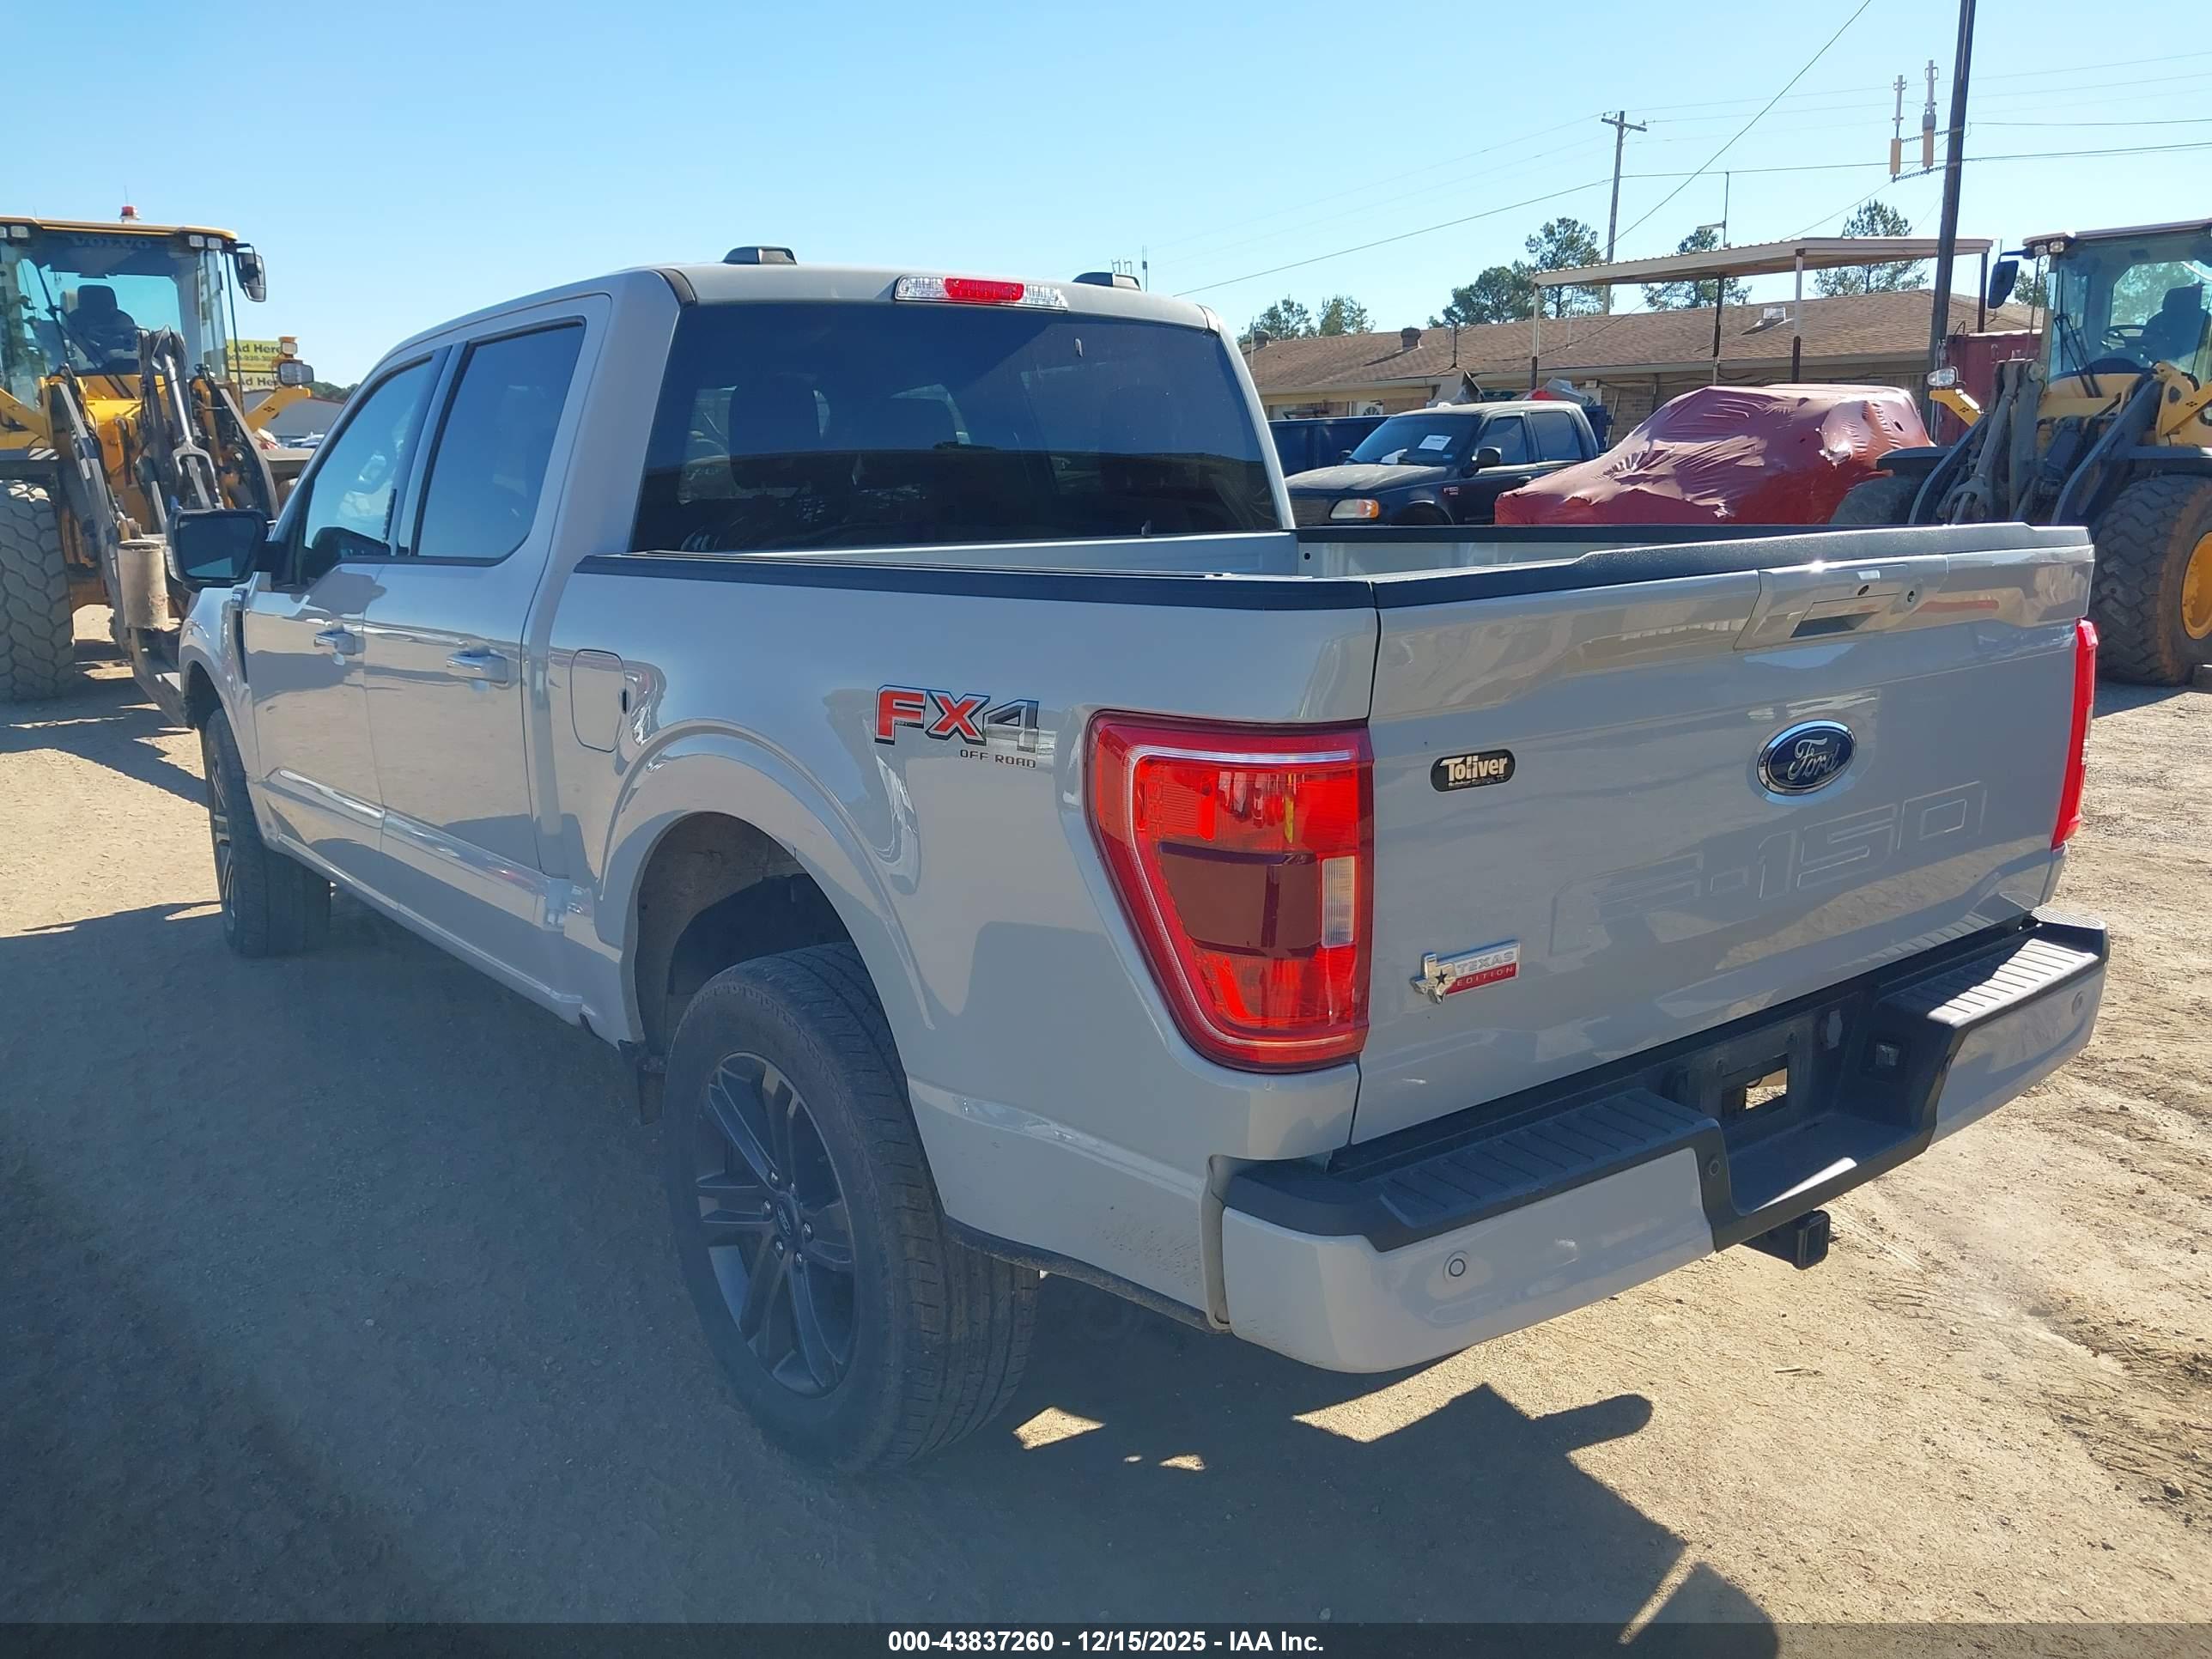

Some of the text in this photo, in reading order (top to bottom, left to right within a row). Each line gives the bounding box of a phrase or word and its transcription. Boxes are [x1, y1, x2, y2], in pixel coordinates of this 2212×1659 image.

[874, 684, 1039, 753] FX4
[959, 749, 1036, 769] OFF ROAD
[1439, 755, 1508, 781] Toliver
[1787, 737, 1841, 781] Ford
[1548, 780, 1989, 956] F-150
[1456, 951, 1515, 975] TEXAS
[1456, 966, 1514, 988] EDITION
